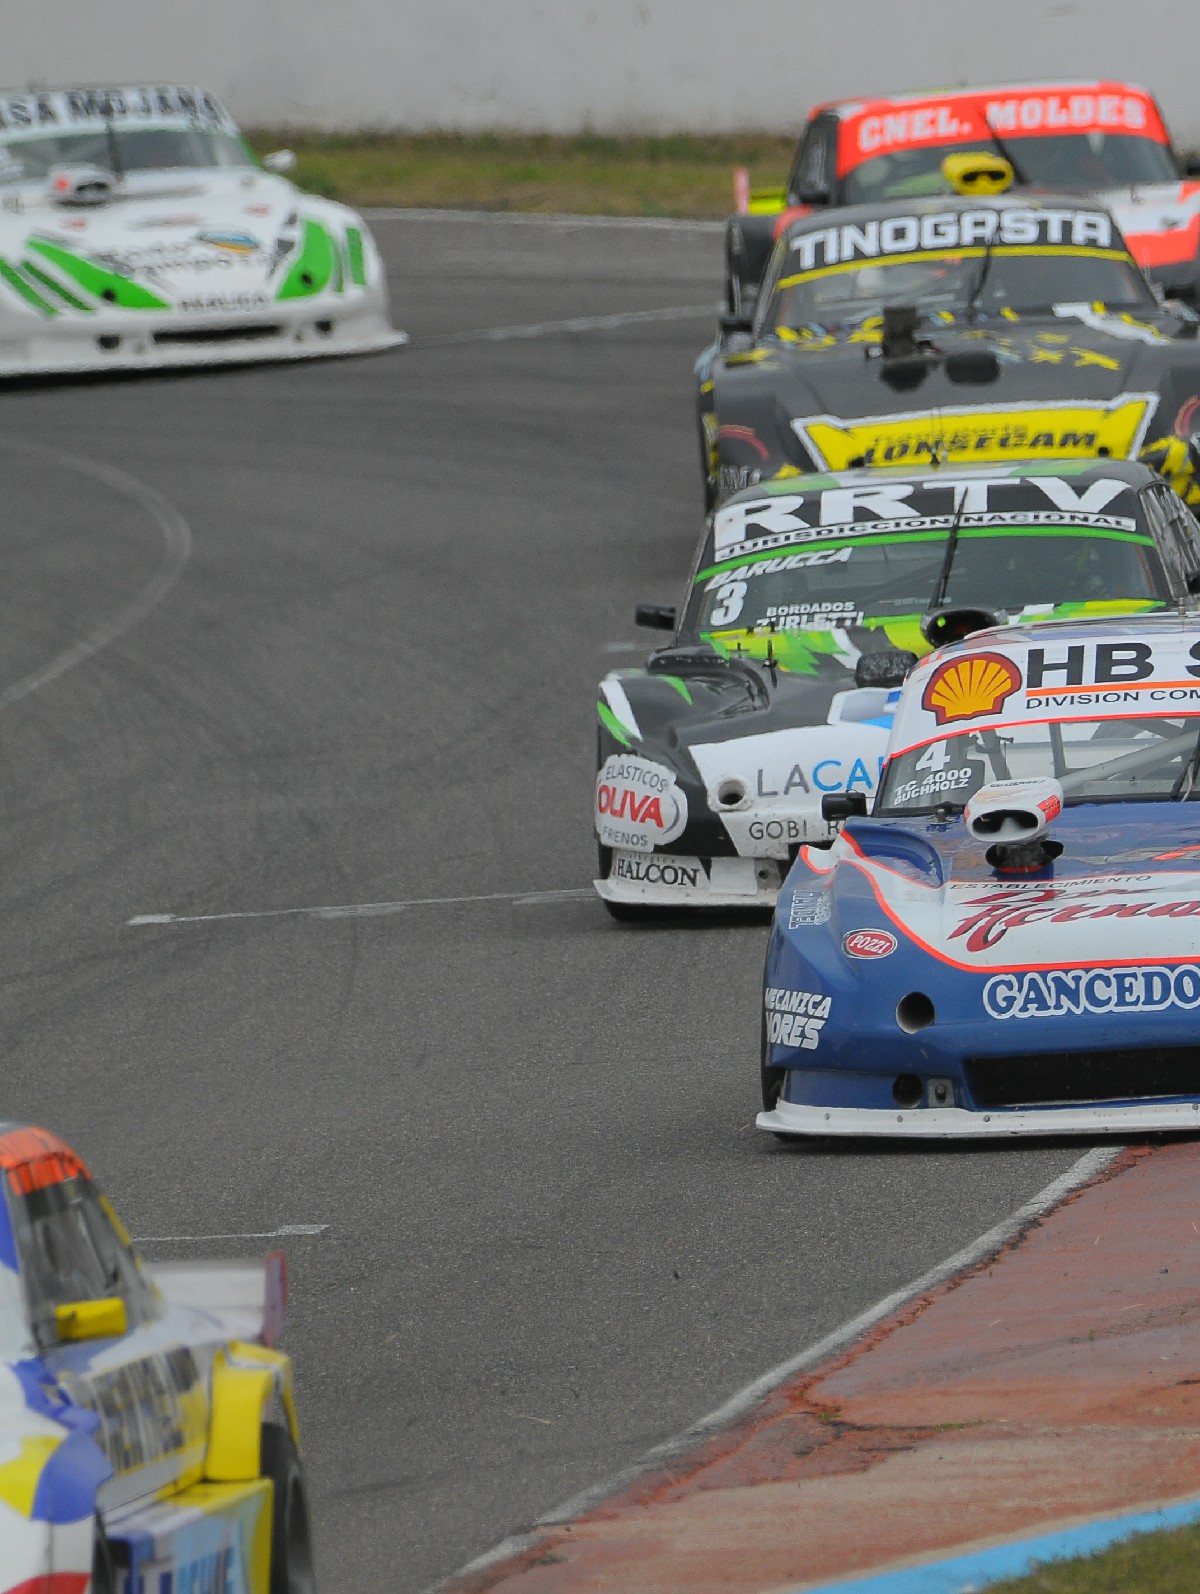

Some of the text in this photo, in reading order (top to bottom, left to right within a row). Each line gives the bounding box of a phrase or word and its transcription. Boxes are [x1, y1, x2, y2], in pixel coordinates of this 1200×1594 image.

[859, 95, 1147, 151] CNEL. MOLDES
[790, 208, 1112, 270] TINOGASTA
[714, 476, 1133, 549] RRTV
[720, 512, 1135, 558] JURISDICCION NACIONAL
[710, 581, 748, 627] 3
[766, 601, 855, 617] BORDADOS
[1025, 642, 1155, 689] HB
[1025, 691, 1139, 710] DIVISION
[916, 739, 950, 771] 4
[606, 765, 667, 792] ELASTICOS
[757, 756, 884, 796] LACA
[895, 767, 972, 796] TC 4000
[598, 784, 664, 827] OLIVA
[893, 779, 968, 806] BUCHHOLZ
[602, 826, 648, 847] FRENOS
[617, 858, 700, 887] HALCON
[950, 875, 1152, 889] ESTABLECIMIENTO
[849, 935, 890, 954] POZZI
